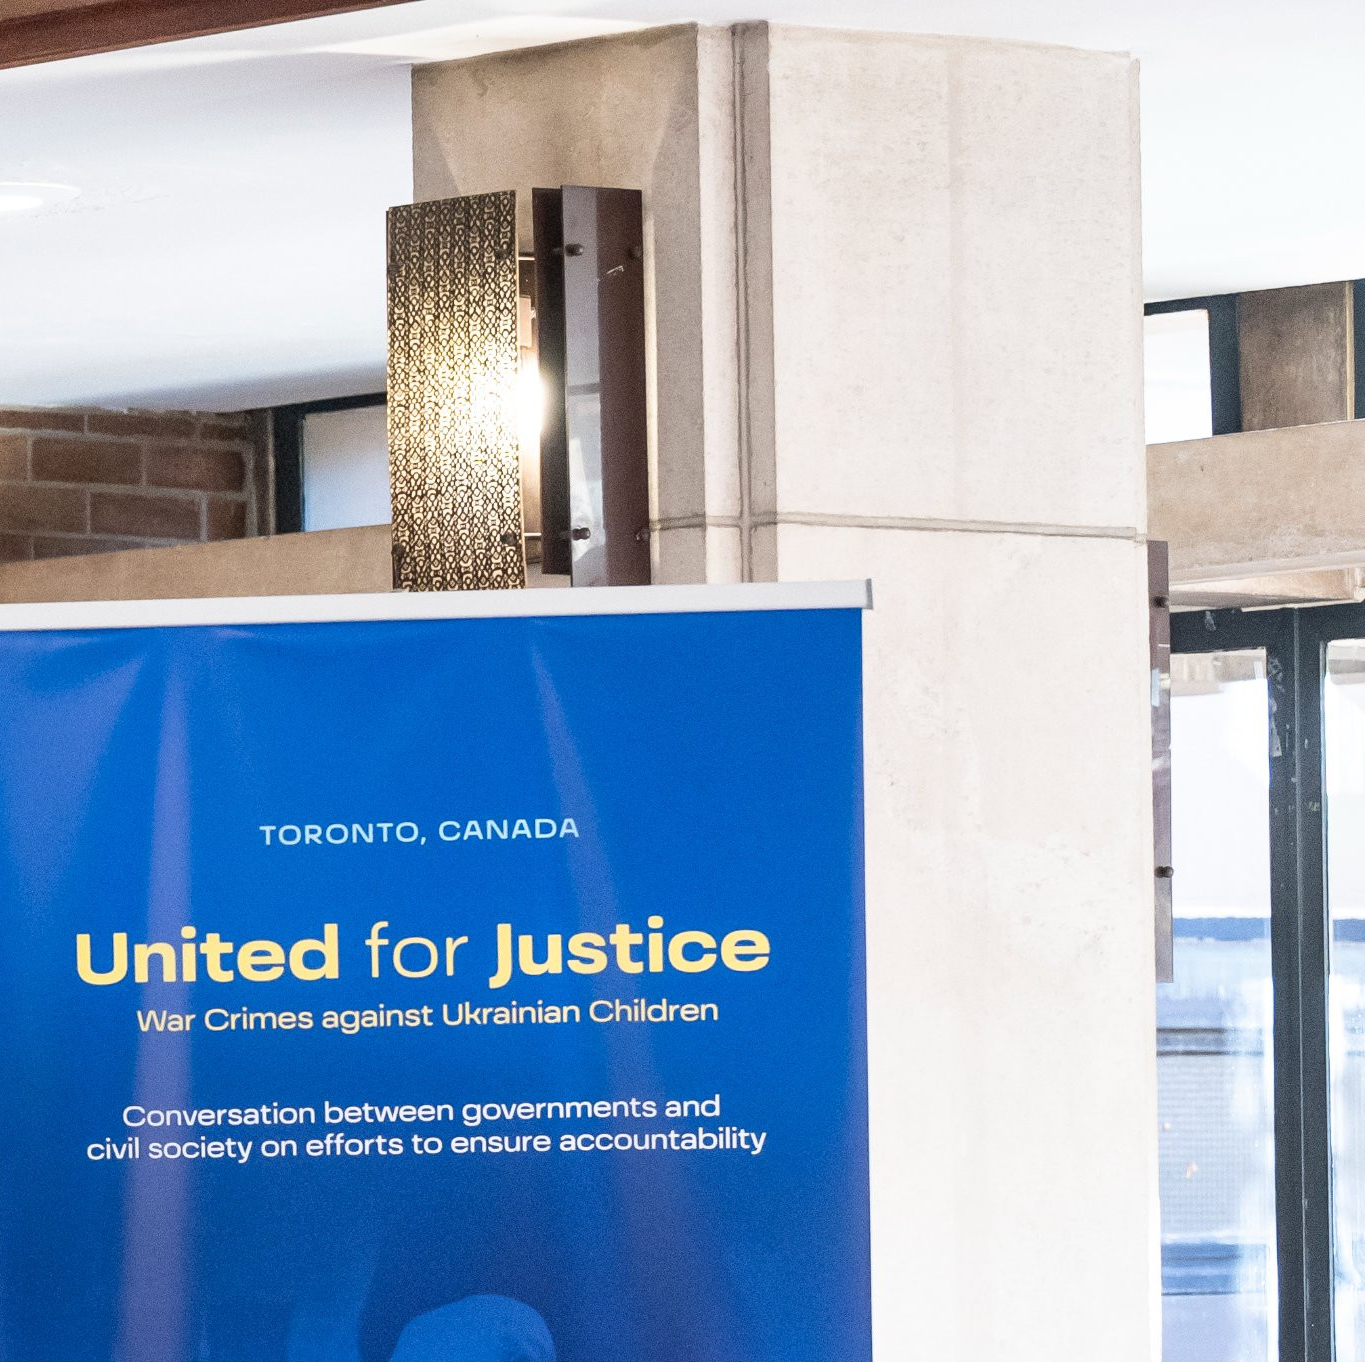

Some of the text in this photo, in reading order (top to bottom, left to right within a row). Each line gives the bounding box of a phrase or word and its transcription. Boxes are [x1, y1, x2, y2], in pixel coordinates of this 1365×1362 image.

[259, 817, 580, 846] TORONTO, CANADA
[75, 914, 771, 990] United for Justice
[136, 997, 719, 1035] War Crimes against Ukrainian Children
[122, 1093, 721, 1127] Conversation between governments and
[86, 1126, 767, 1164] civil society on efforts to ensure accountability
